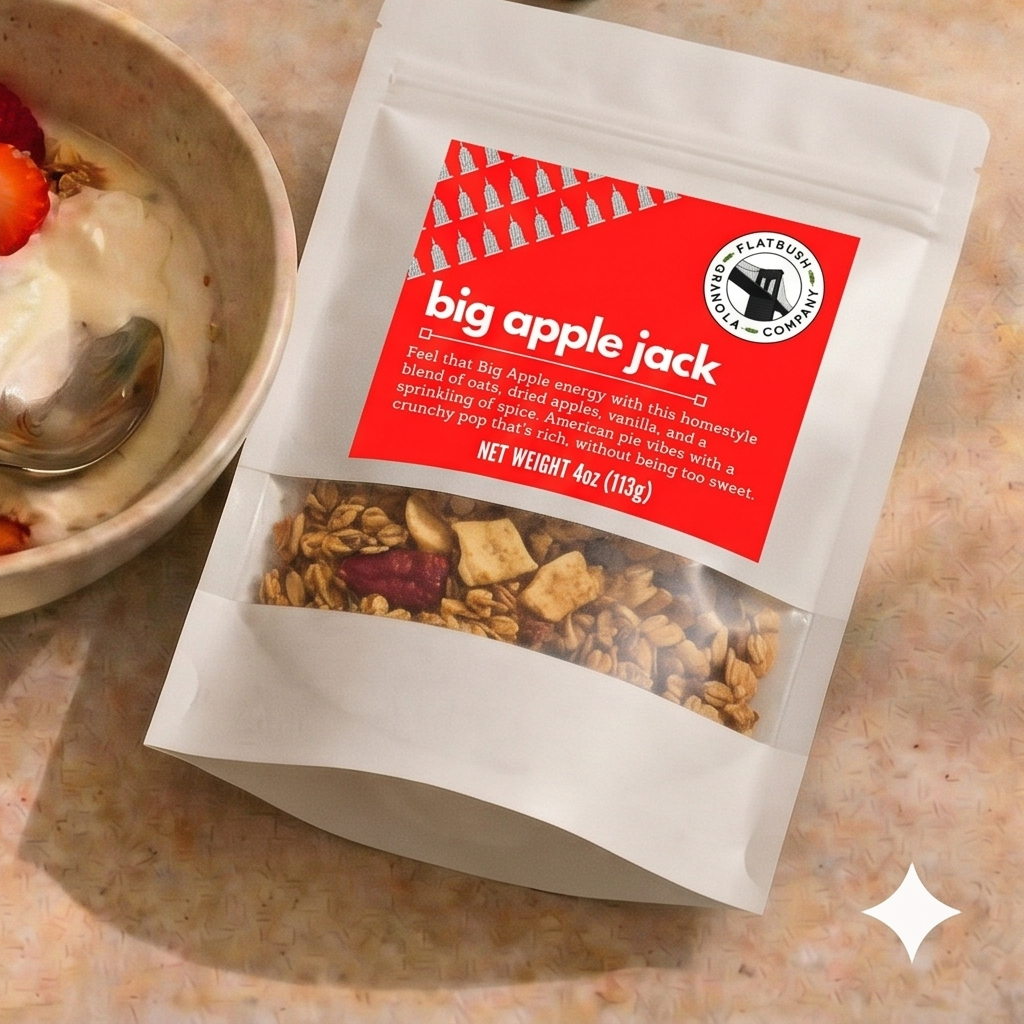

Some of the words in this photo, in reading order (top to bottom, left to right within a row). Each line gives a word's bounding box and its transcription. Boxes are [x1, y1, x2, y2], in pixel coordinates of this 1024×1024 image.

[736, 238, 812, 269] FLATBUSH
[425, 279, 495, 338] big
[503, 311, 623, 358] apple
[622, 329, 721, 385] jack
[710, 264, 740, 330] GRANOLA
[762, 288, 819, 337] COMPANY
[397, 383, 474, 409] sprinkling
[478, 398, 496, 409] of
[497, 403, 539, 424] spice.
[544, 412, 614, 439] American
[617, 433, 641, 453] pie
[647, 440, 684, 459] vibes
[690, 453, 721, 470] with
[726, 466, 734, 475] a
[402, 362, 445, 381] blend
[448, 374, 466, 385] of
[468, 379, 501, 395] oats,
[508, 386, 547, 404] dried
[551, 398, 601, 419] apples,
[609, 412, 660, 435] vanilla,
[666, 429, 695, 444] and
[698, 439, 706, 448] a
[407, 346, 439, 362] Feel
[443, 353, 473, 369] that
[477, 360, 503, 380] Big
[506, 368, 550, 393] Apple
[555, 382, 606, 403] energy
[612, 395, 642, 411] with
[648, 403, 675, 420] this
[680, 411, 757, 444] homestyle
[393, 399, 455, 422] crunchy
[457, 413, 487, 429] pop
[492, 417, 532, 436] that's
[537, 429, 568, 447] rich,
[576, 440, 631, 462] without
[635, 452, 678, 478] being
[682, 468, 705, 483] too
[709, 478, 754, 500] sweet.
[477, 440, 509, 463] NET
[512, 447, 571, 478] WEIGHT
[572, 463, 601, 487] 4oz
[604, 470, 652, 504] (113g)
